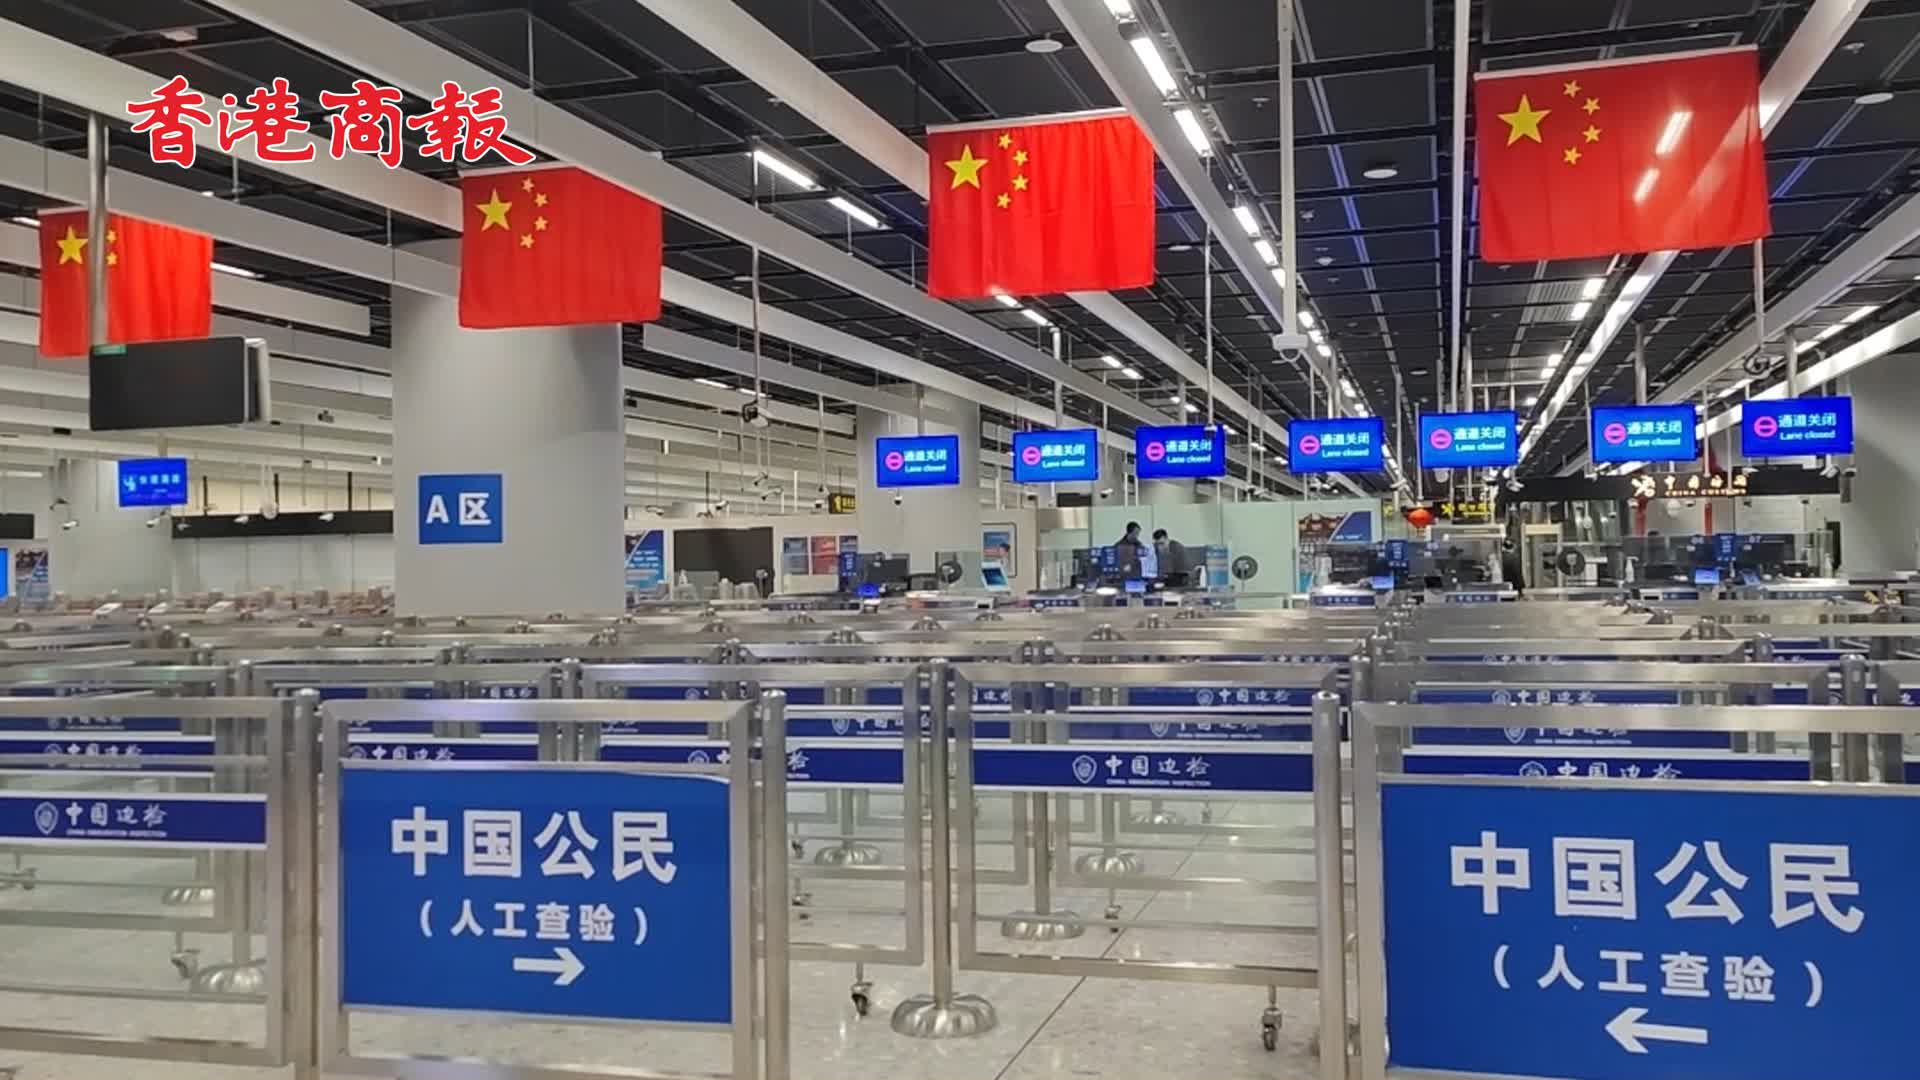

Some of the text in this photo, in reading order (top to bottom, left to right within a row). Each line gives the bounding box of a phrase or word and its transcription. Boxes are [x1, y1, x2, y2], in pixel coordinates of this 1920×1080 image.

[1778, 412, 1837, 427] 通道关闭
[1454, 427, 1506, 440] 通道关闭
[1627, 420, 1682, 434] 通道关闭
[1320, 432, 1369, 445] 通道关闭
[1780, 430, 1836, 440] Lane closed
[1166, 439, 1212, 452] 通道关闭
[1343, 448, 1369, 456] closed
[1456, 442, 1504, 452] Lane closed
[1104, 754, 1211, 778] 中国边检
[65, 801, 168, 828] 中国边检
[391, 806, 677, 884] 中国公民
[1450, 831, 1865, 934] 中国公民
